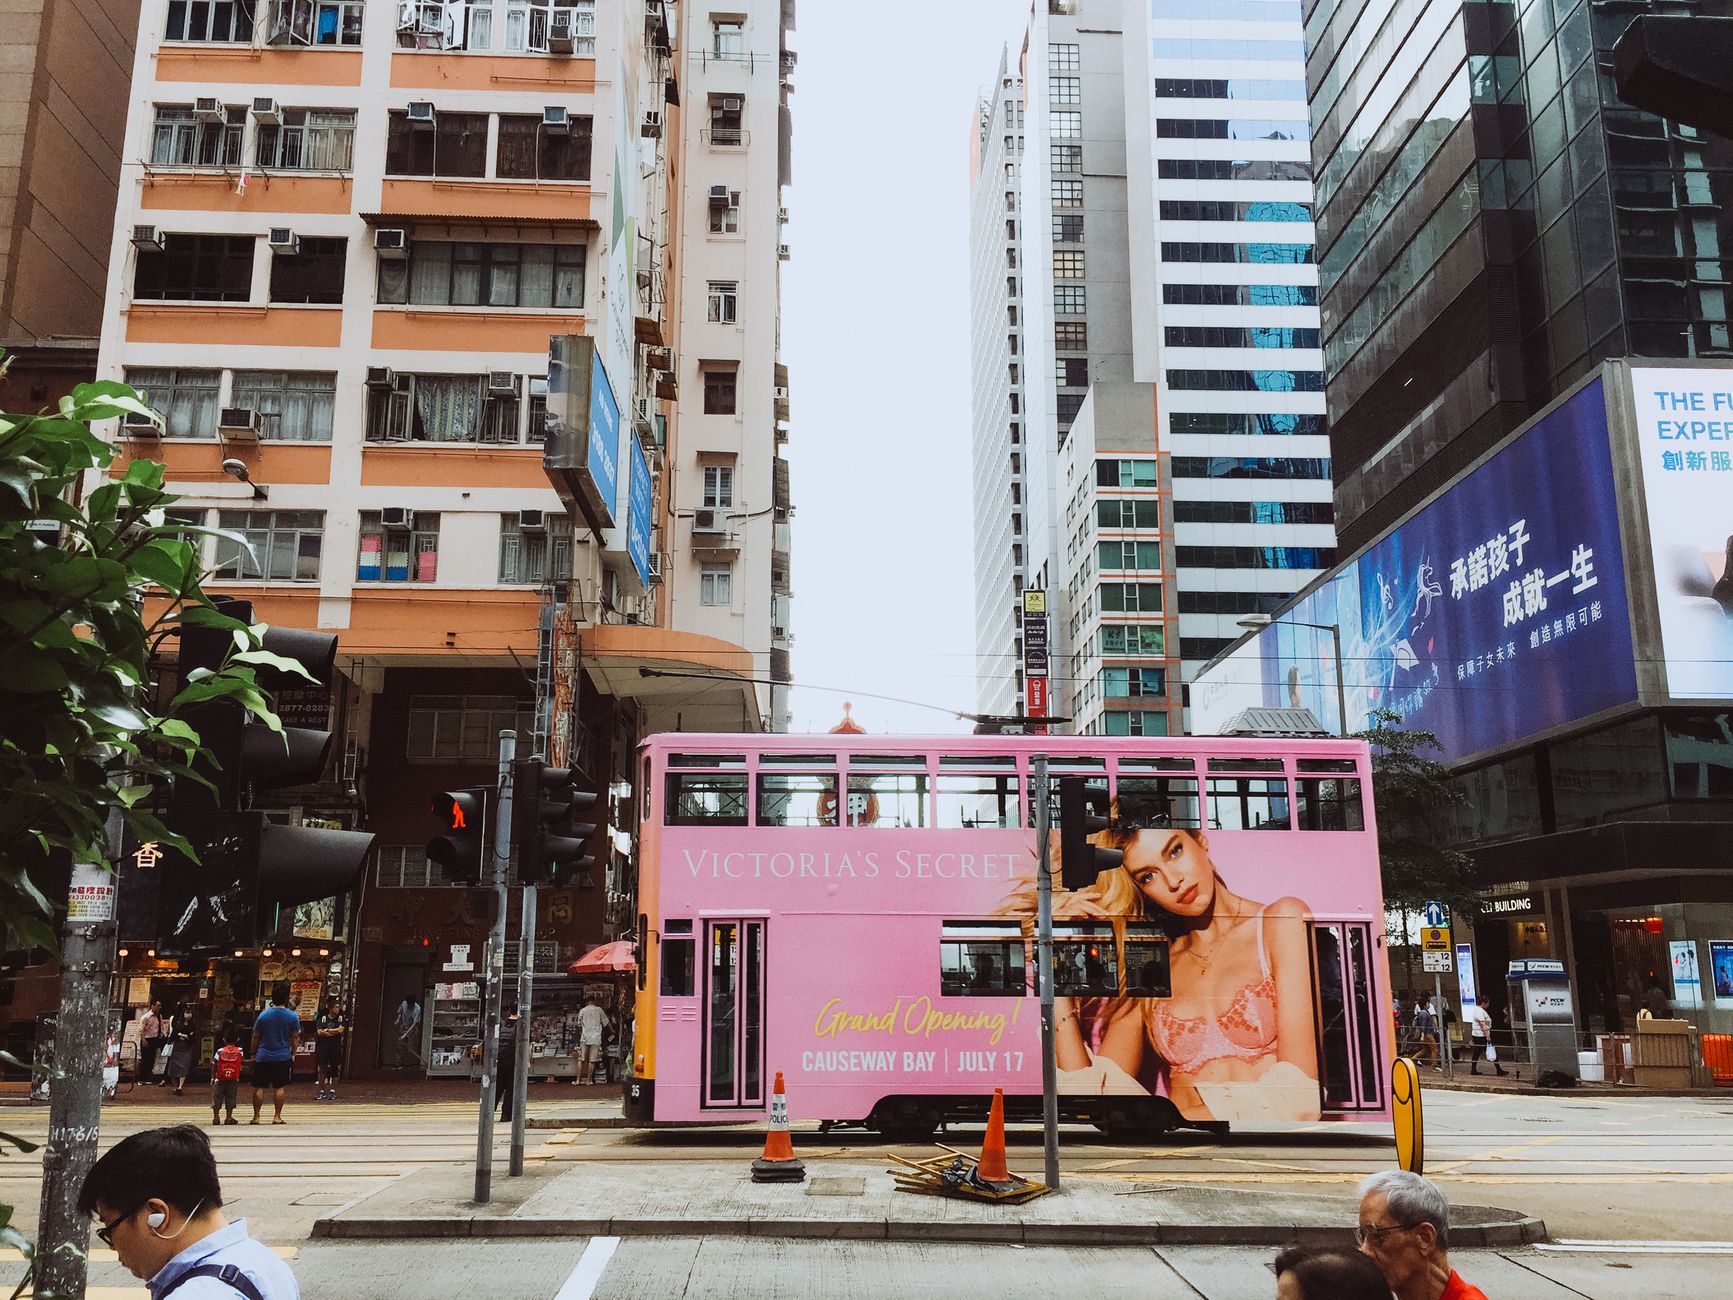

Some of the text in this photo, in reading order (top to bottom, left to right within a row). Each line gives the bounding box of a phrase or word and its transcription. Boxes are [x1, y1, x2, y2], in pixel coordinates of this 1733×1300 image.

[1654, 391, 1705, 411] THE
[1661, 450, 1732, 471] 創新服
[1449, 518, 1530, 600] 承諾孩子
[1503, 543, 1598, 628] 成就一生
[1456, 600, 1602, 682] 保障子女未來 創造無限可能
[683, 849, 1020, 879] VICTORIA'S SECRET
[1494, 898, 1531, 912] BUILDING
[1440, 952, 1450, 960] 12
[1441, 963, 1451, 972] 12
[814, 995, 1023, 1045] Grand Opening!
[801, 1051, 1024, 1072] CAUSEWAY BAY JULY 17
[631, 1084, 640, 1098] 35
